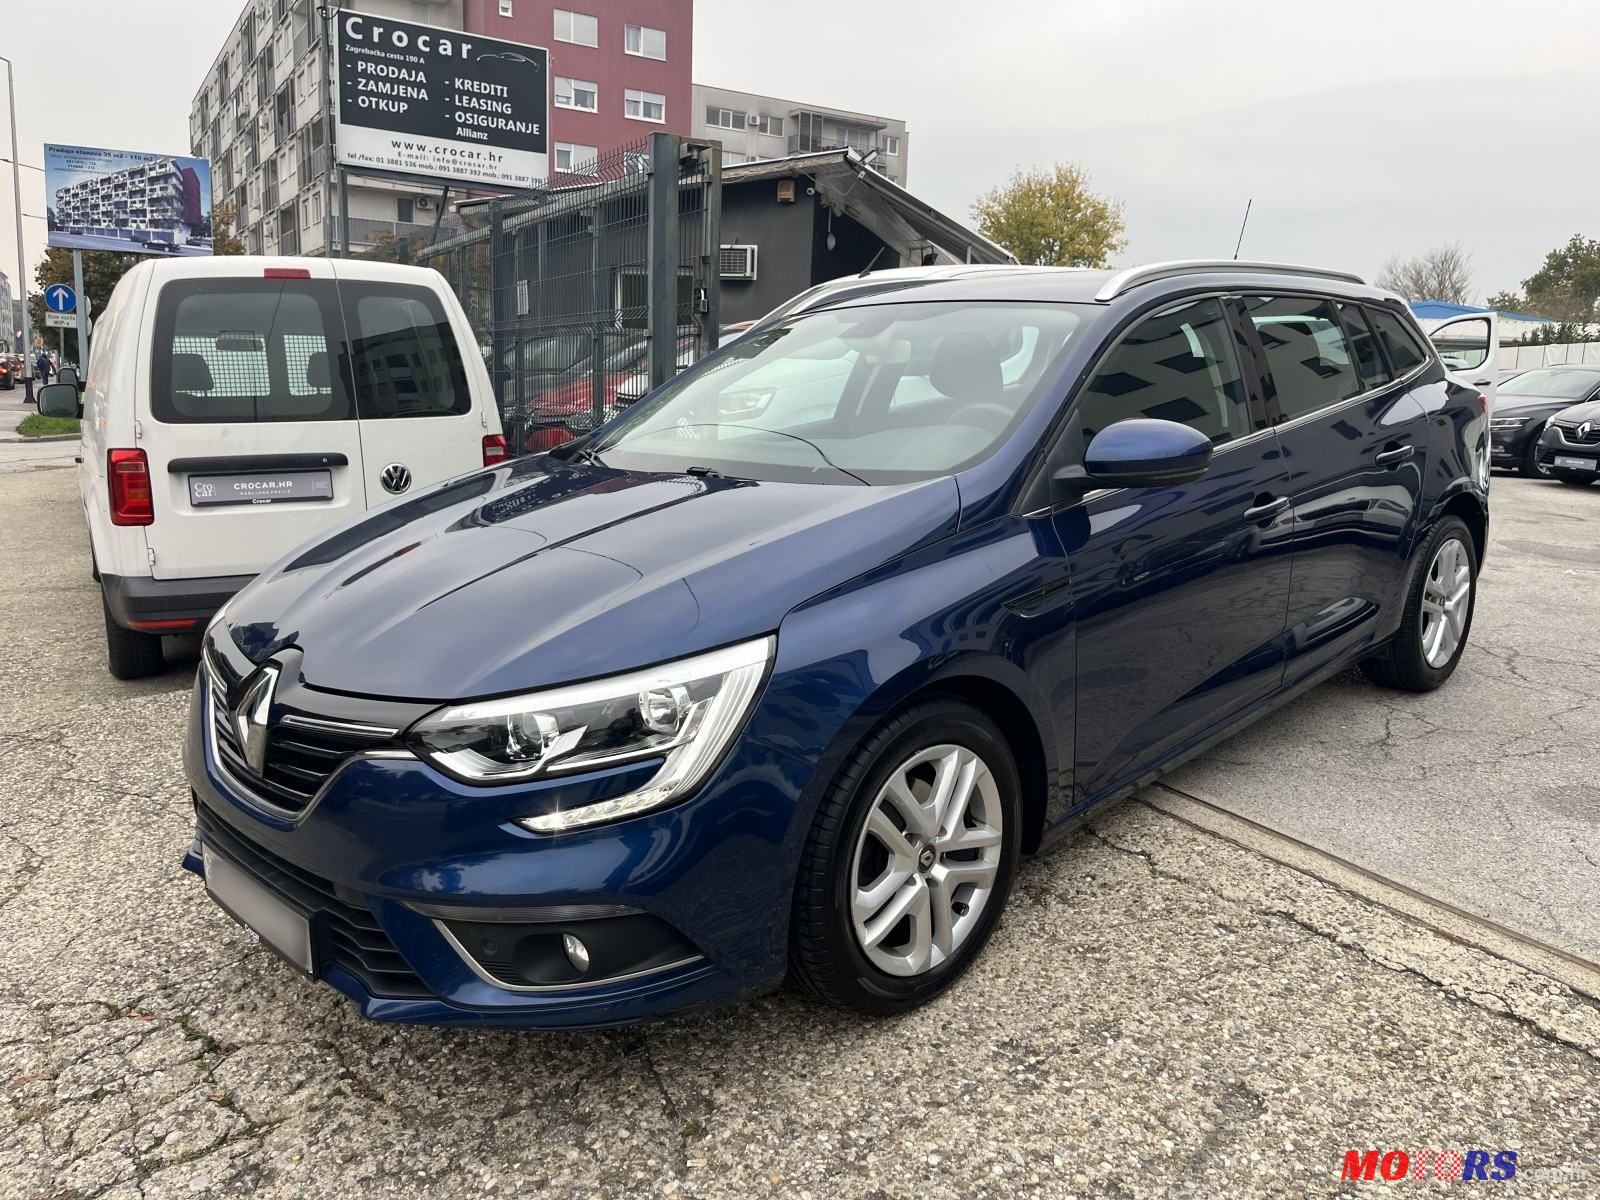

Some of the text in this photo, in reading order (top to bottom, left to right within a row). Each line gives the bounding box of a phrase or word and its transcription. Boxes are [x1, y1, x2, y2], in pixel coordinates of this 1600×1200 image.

[345, 17, 472, 59] Crocar
[345, 44, 385, 58] Zagrebačka
[386, 52, 404, 61] cesta
[405, 55, 418, 64] 190
[357, 61, 427, 84] PRODAJA
[357, 78, 429, 101] ZAMJENA
[455, 78, 508, 98] KREDITI
[358, 95, 409, 114] OTKUP
[455, 94, 512, 114] LEASING
[455, 111, 540, 135] OSIGURANJE
[456, 127, 488, 141] Allianz
[391, 140, 503, 163] www.crocar.hr
[386, 158, 403, 166] 3881
[438, 164, 451, 173] 091
[452, 166, 470, 175] 3887
[194, 482, 213, 491] Cro
[195, 488, 214, 498] car
[233, 480, 293, 490] CROCAR.HR
